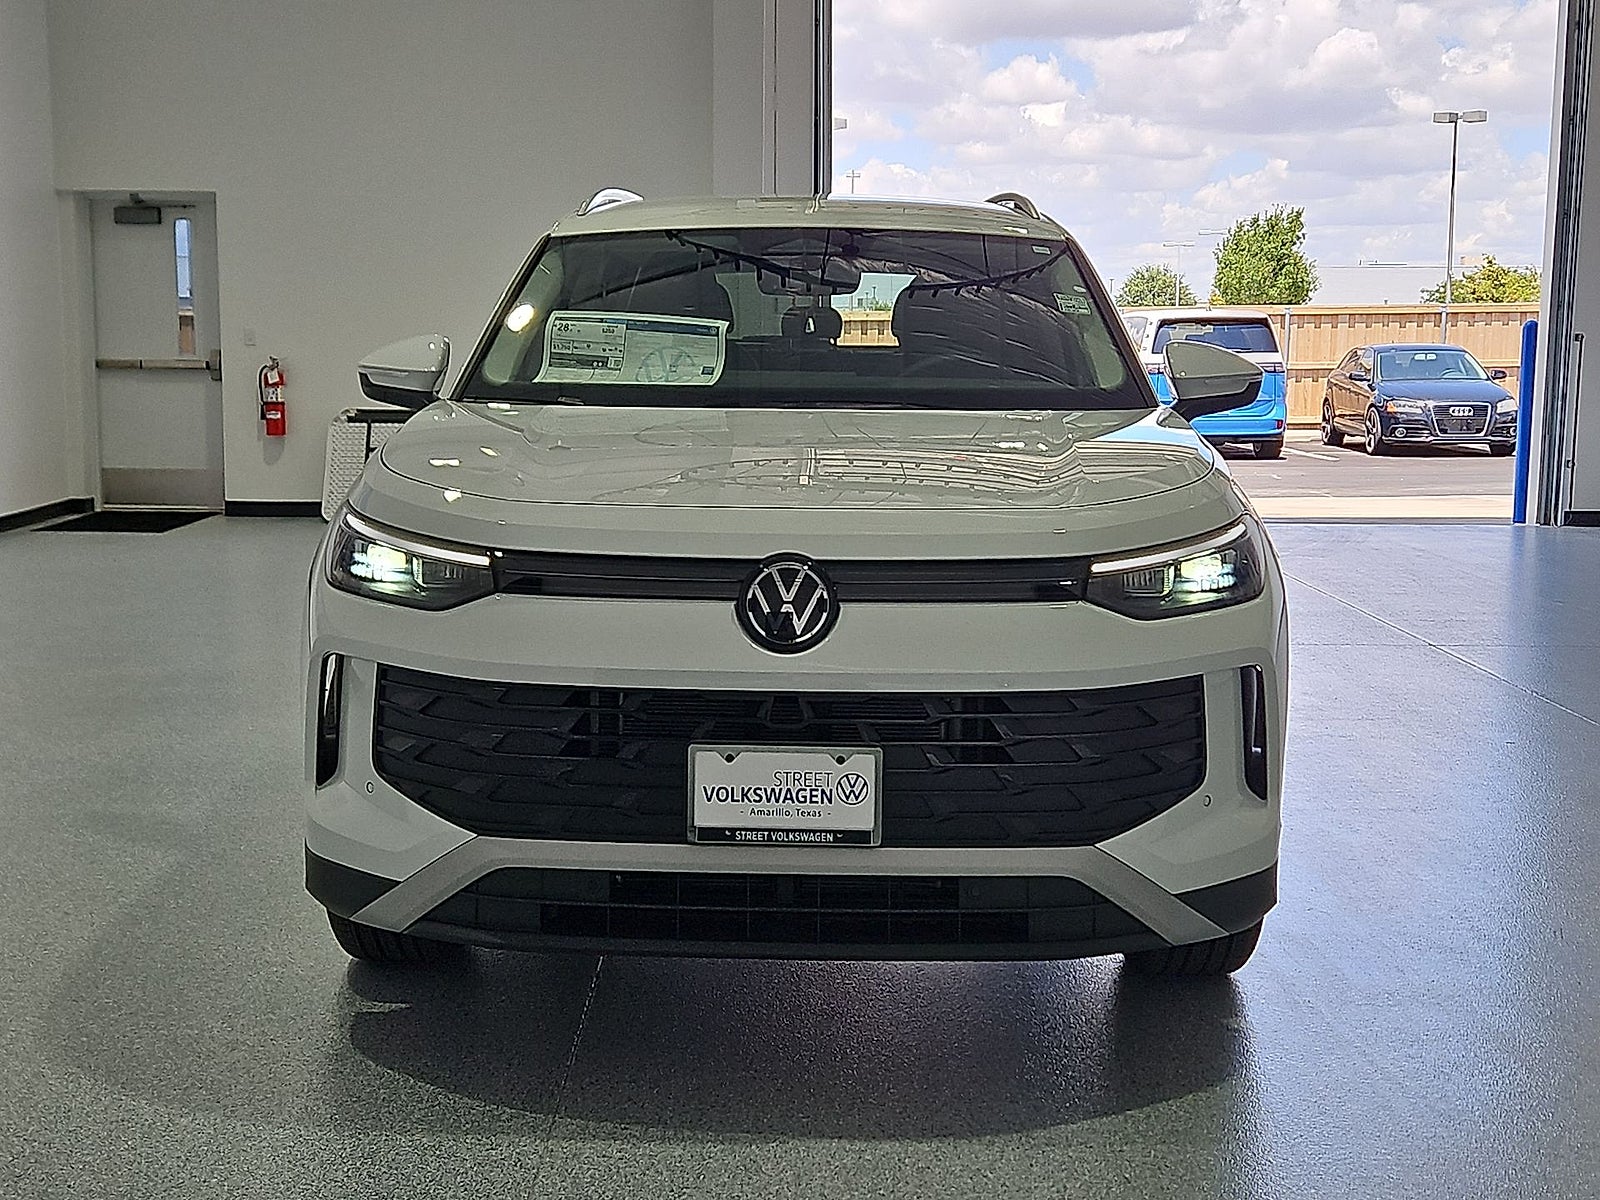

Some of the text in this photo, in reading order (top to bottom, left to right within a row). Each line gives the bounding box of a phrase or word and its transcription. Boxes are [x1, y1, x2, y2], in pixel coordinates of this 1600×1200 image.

[556, 322, 570, 332] 28
[773, 770, 834, 788] STREET
[702, 785, 834, 805] VOLKSWAGEN
[749, 807, 822, 818] Amarillo, Texas
[735, 830, 834, 842] STREET VOLKSWAGEN
